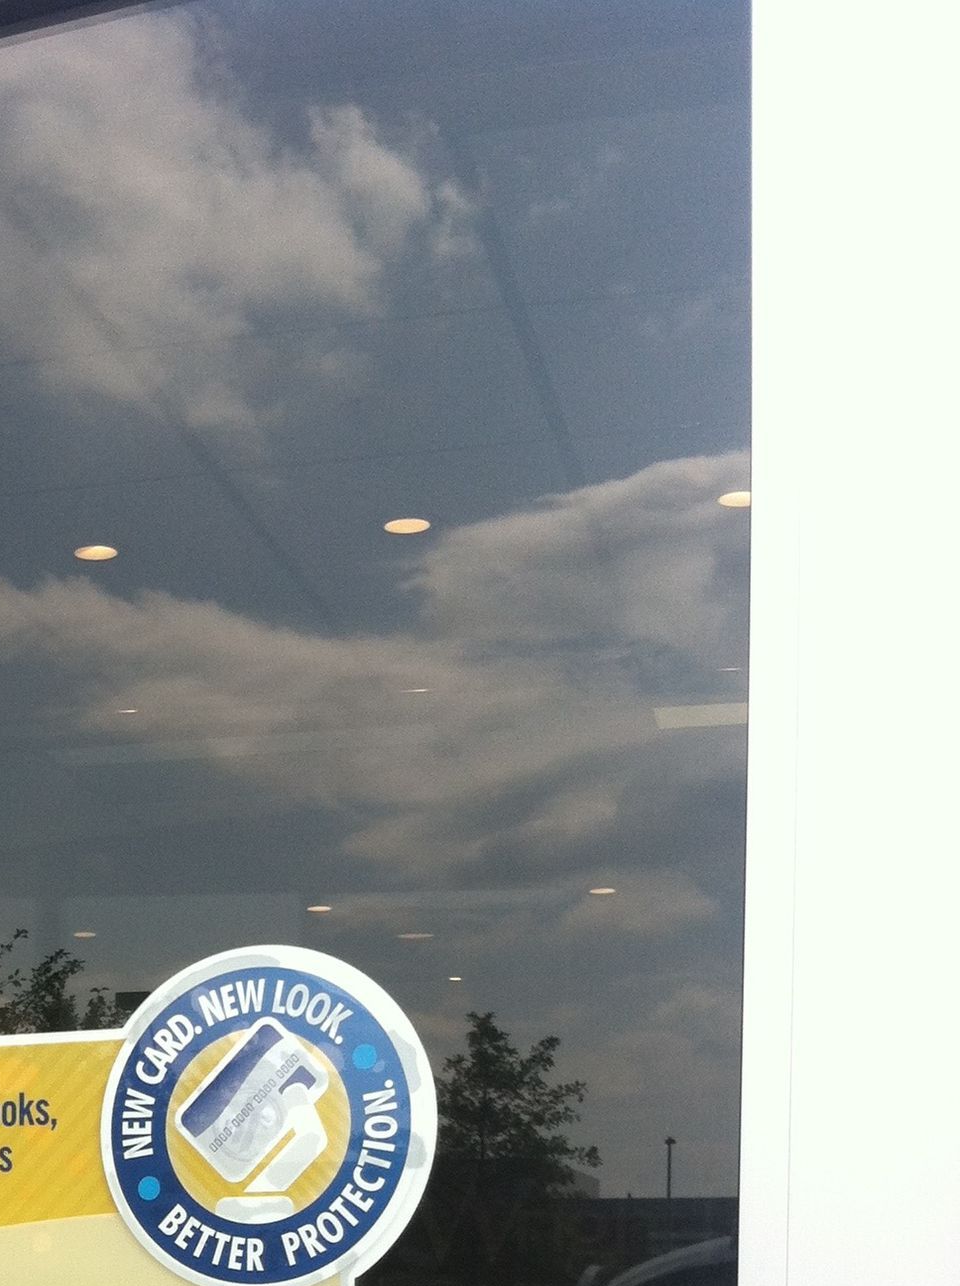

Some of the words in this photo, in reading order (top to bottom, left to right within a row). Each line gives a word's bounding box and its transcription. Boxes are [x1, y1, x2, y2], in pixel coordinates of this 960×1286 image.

[198, 979, 266, 1027] NEW
[272, 979, 354, 1045] LOOK.
[136, 1014, 202, 1085] CARD.
[122, 1088, 157, 1159] NEW
[158, 1203, 265, 1272] BETTER
[281, 1079, 398, 1267] PROTECTION.
